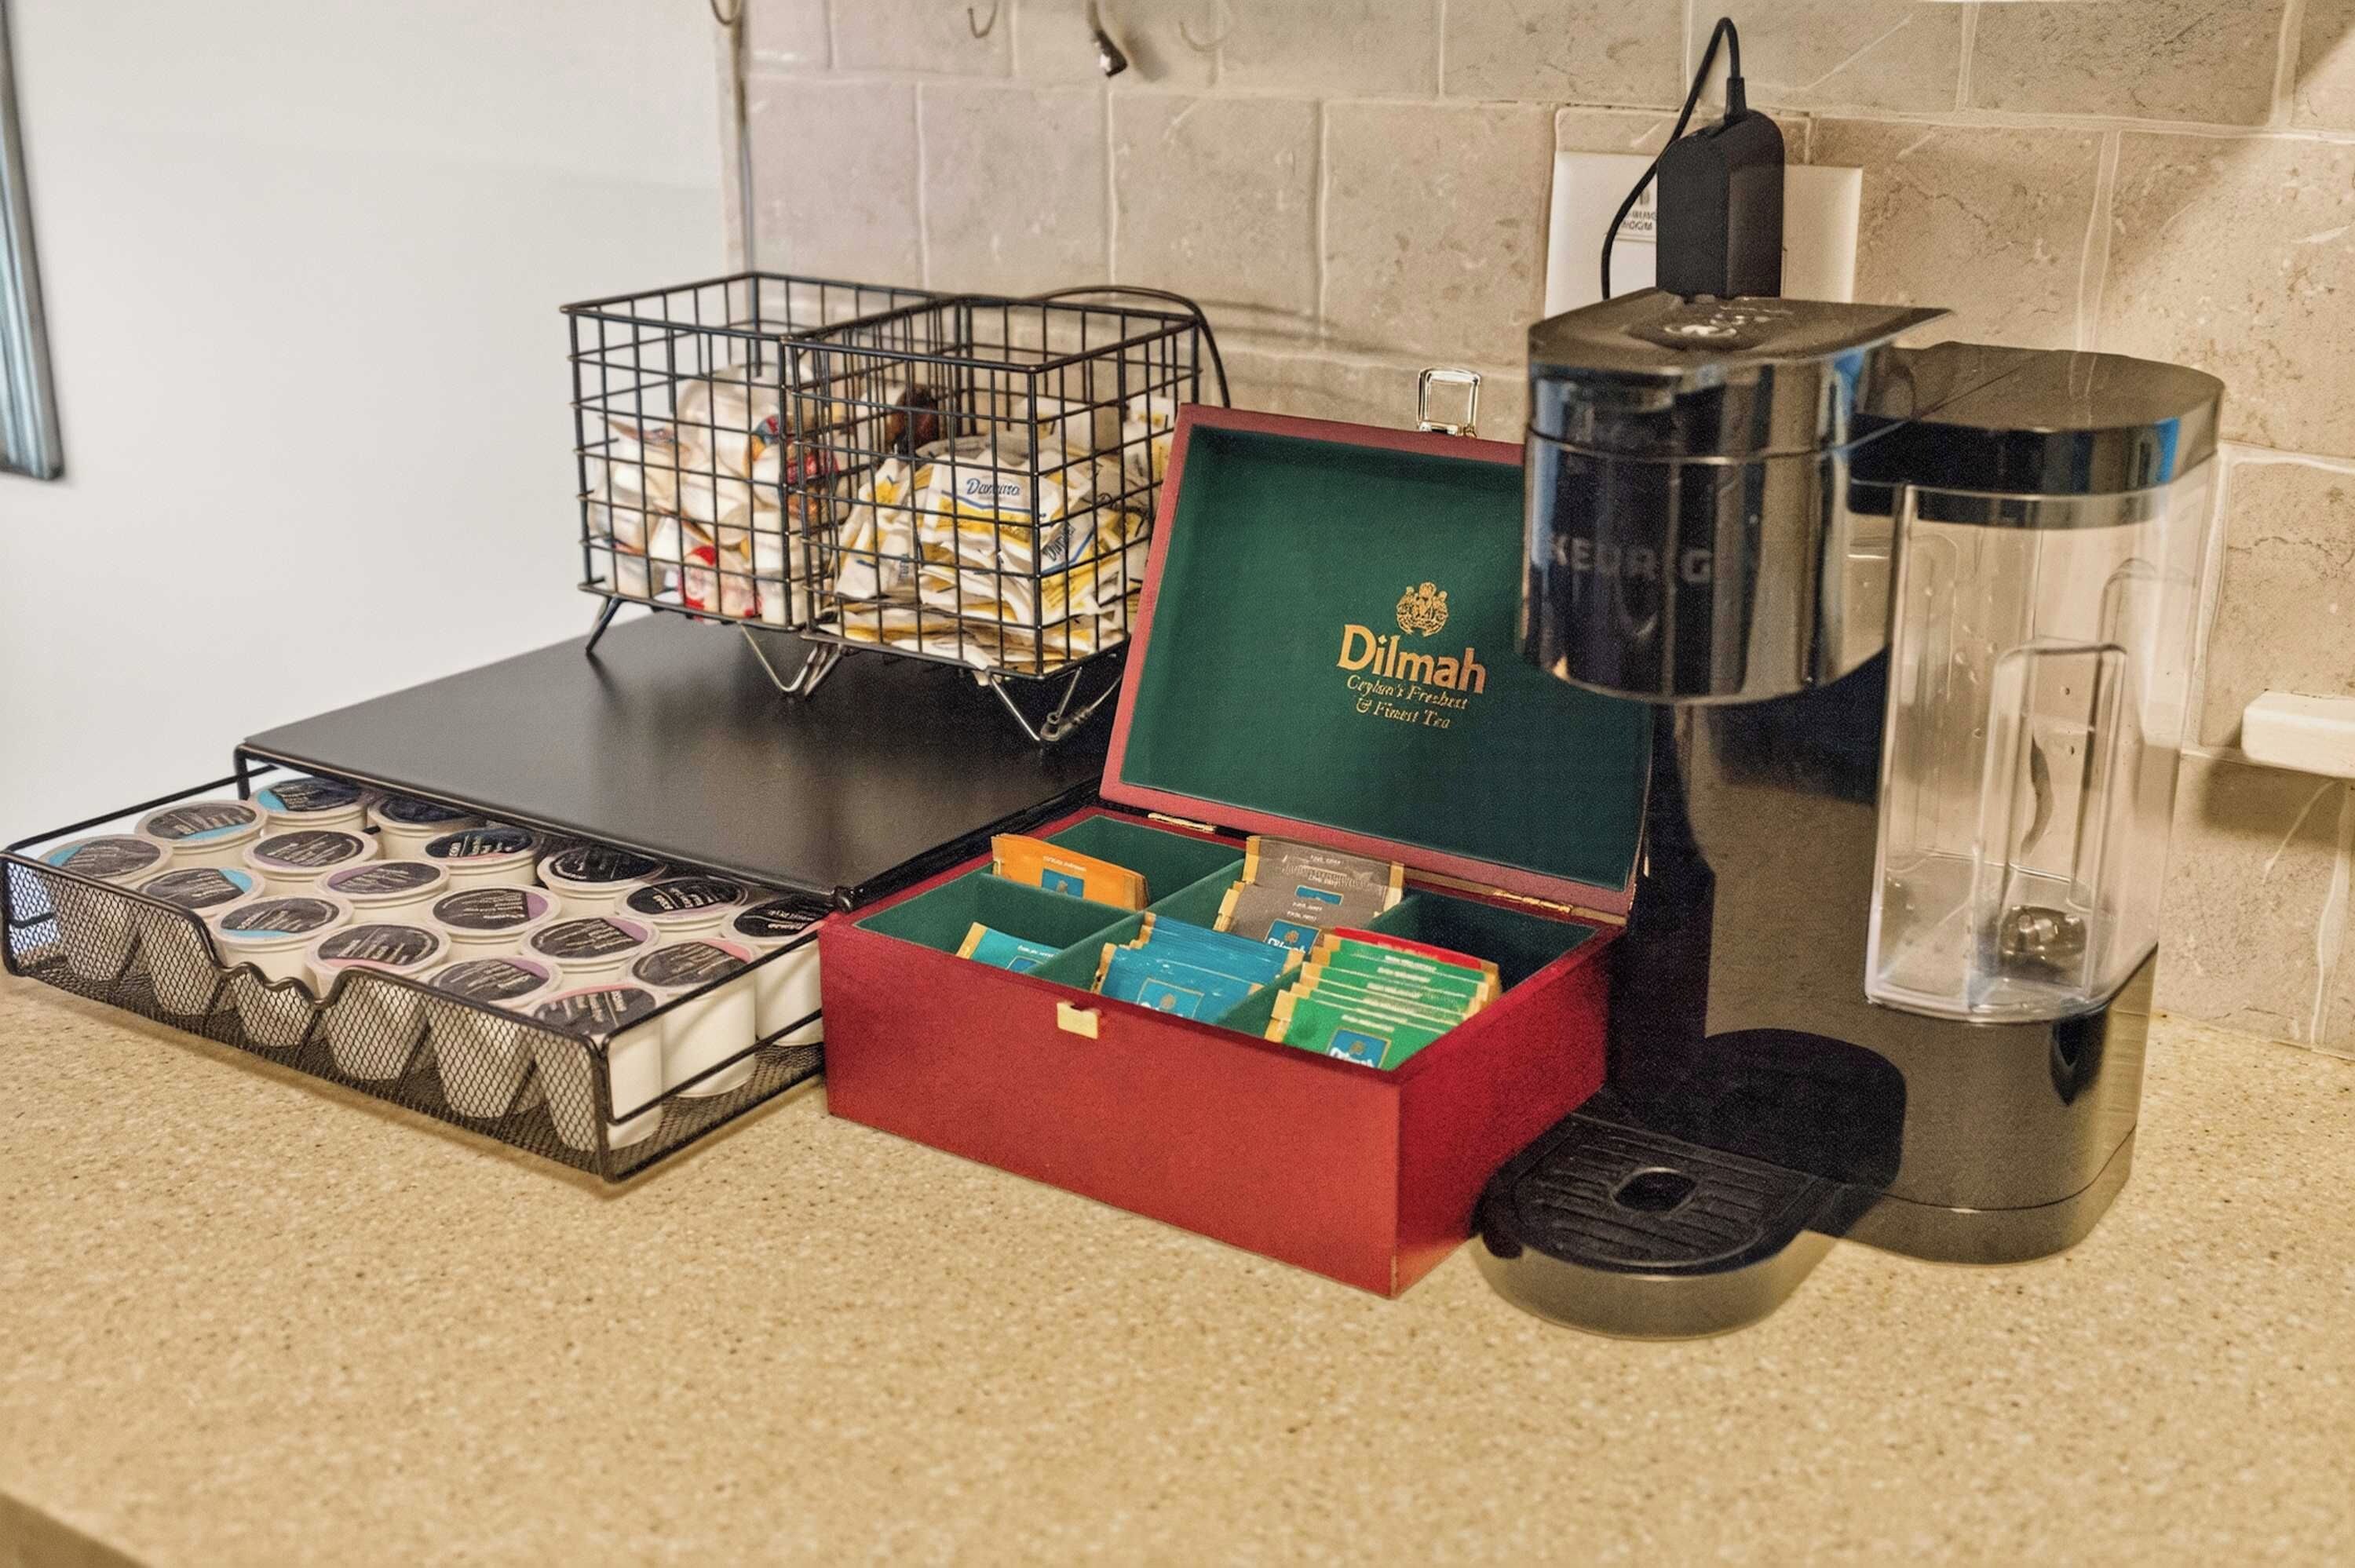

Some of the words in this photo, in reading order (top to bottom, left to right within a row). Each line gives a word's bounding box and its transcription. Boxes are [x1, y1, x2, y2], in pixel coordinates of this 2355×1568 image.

[1336, 623, 1487, 695] Dilmah
[1346, 673, 1404, 698] Ceylon's
[1405, 684, 1470, 710] Freshest
[1356, 697, 1373, 714] &
[1373, 700, 1420, 723] Finest
[1423, 709, 1451, 729] Tea
